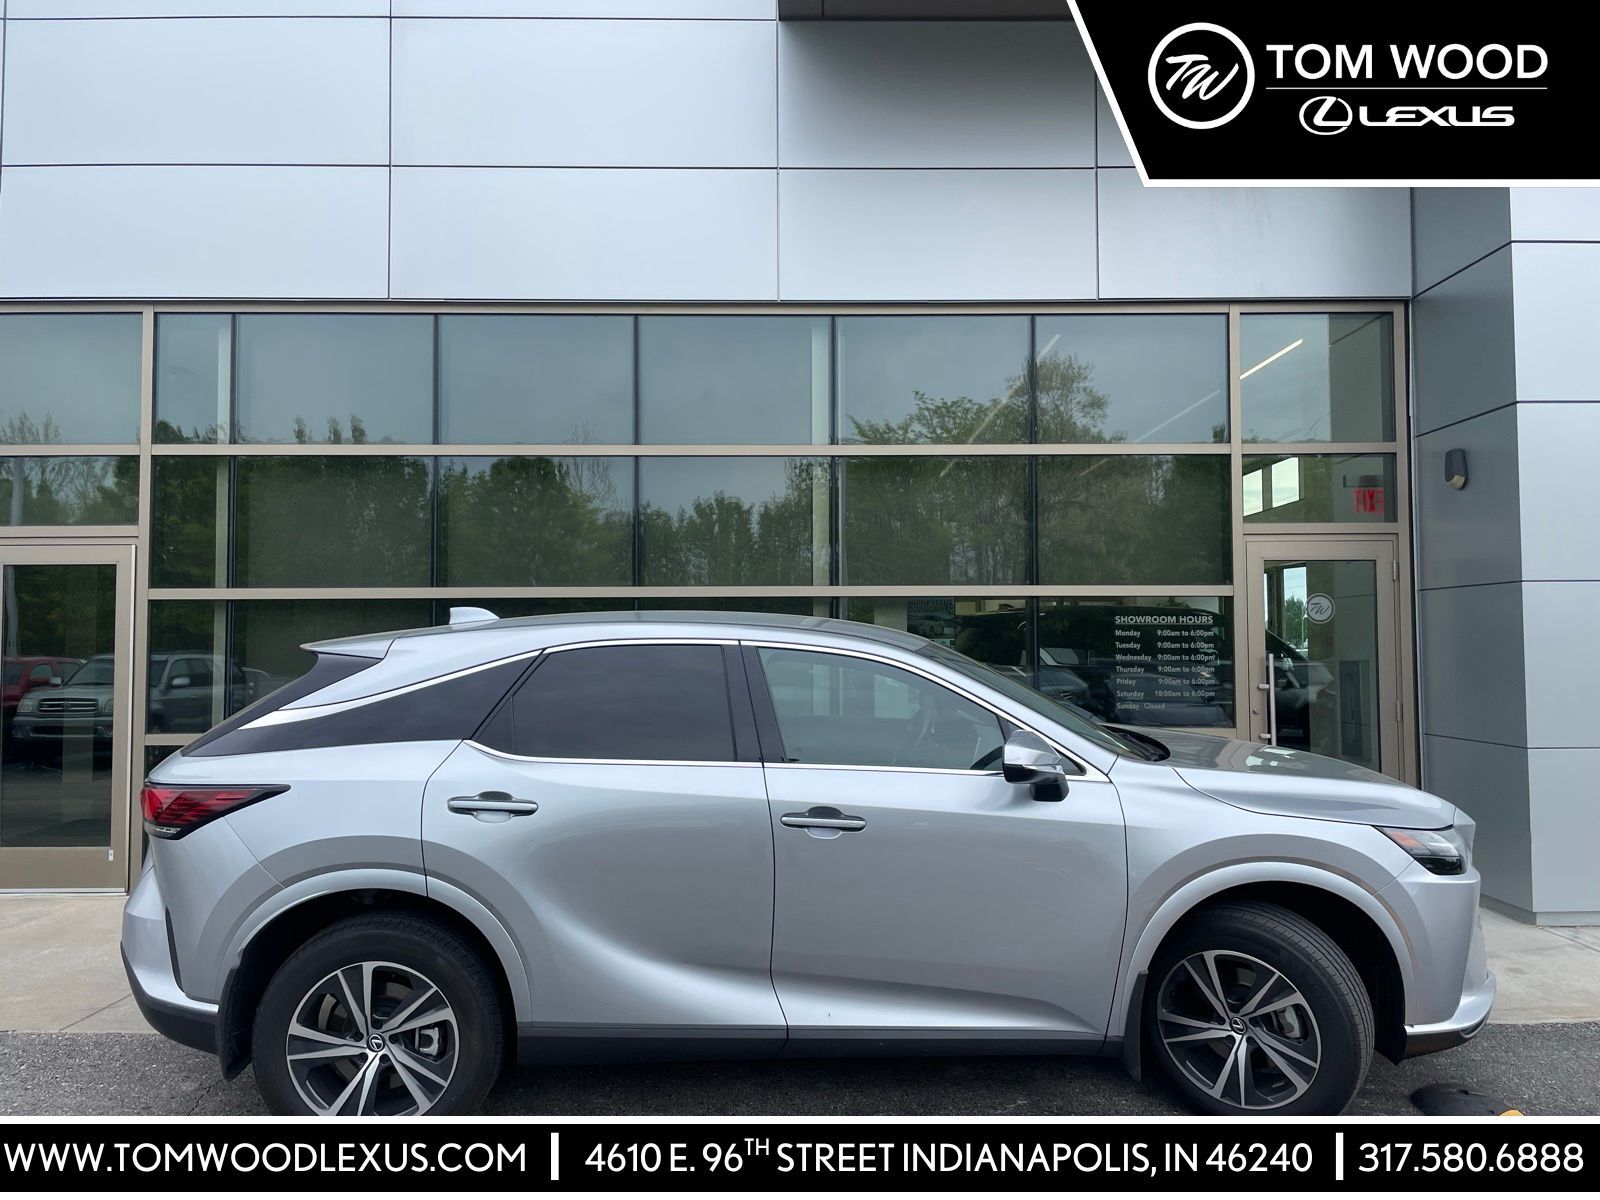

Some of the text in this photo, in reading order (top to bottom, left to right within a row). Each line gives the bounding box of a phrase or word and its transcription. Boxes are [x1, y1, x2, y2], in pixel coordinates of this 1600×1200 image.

[1115, 615, 1214, 624] SHOWROOM HOURS
[1115, 630, 1141, 638] Monday
[1157, 629, 1180, 637] 9:00am
[1190, 630, 1214, 638] 6:00pm
[1115, 642, 1141, 650] Tuesday
[1157, 641, 1180, 649] 9:00am
[1190, 642, 1215, 650] 6:00pm
[1115, 654, 1152, 662] Wednesday
[1190, 654, 1214, 662] 6:00pm
[1116, 666, 1145, 674] Thursday
[1191, 666, 1215, 674] 6:00pm
[1116, 679, 1137, 687] Friday
[1191, 679, 1215, 687] 6:00pm
[1116, 691, 1145, 699] Saturday
[1191, 690, 1215, 698] 6:00pm
[1116, 702, 1166, 711] Sunday Closed
